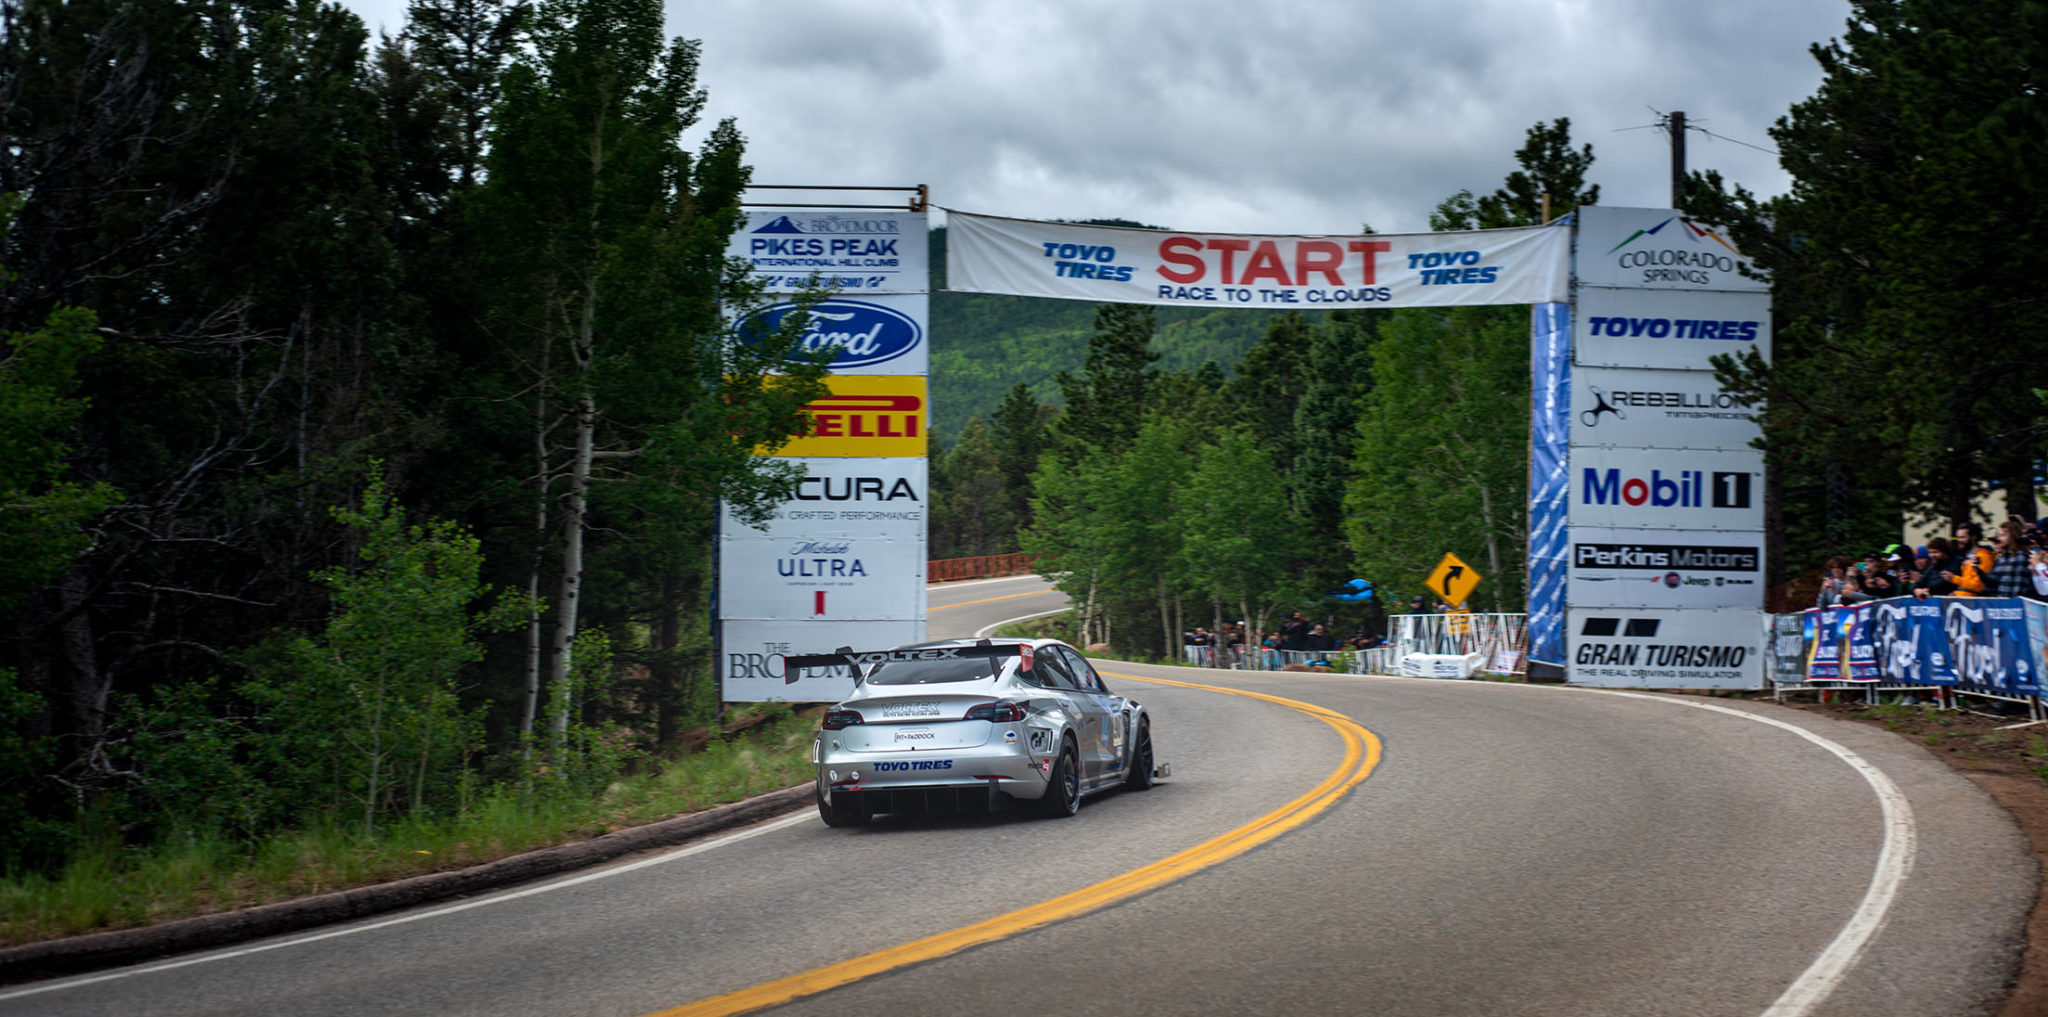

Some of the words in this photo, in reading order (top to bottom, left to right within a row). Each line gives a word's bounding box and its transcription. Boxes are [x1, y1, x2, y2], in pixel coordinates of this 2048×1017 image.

[810, 220, 899, 232] BROADMOOR
[750, 238, 825, 256] PIKES
[830, 238, 899, 256] PEAK
[1043, 242, 1116, 263] TOYO
[751, 258, 836, 266] INTERNATIONAL
[864, 259, 900, 267] CLIMB
[1156, 236, 1391, 286] START
[1407, 251, 1480, 269] TOYO
[1619, 249, 1734, 273] COLORADO
[1054, 260, 1135, 282] TIRES
[1420, 265, 1499, 286] TIRES
[1643, 268, 1710, 285] SPRINGS
[1158, 285, 1218, 301] RACE
[1225, 288, 1252, 302] TO
[1259, 289, 1299, 303] THE
[1306, 287, 1392, 303] CLOUDS
[1589, 316, 1672, 339] TOYO
[1675, 319, 1759, 341] TIRES
[758, 477, 919, 501] ACURA
[1583, 467, 1703, 508] Mobil
[1722, 474, 1738, 506] 1
[788, 511, 837, 521] CRAFTED
[840, 511, 921, 521] PERFORMANCE
[1578, 546, 1670, 566] Perkins
[1671, 549, 1755, 568] Motors
[777, 558, 867, 577] ULTRA
[763, 642, 792, 654] THE
[844, 648, 960, 665] VOLTEX
[1576, 643, 1639, 666] GRAN
[1645, 644, 1746, 668] TURISMO
[1578, 668, 1598, 677] THE
[1600, 669, 1628, 677] REAL
[1630, 669, 1675, 678] DRIVING
[1678, 670, 1743, 679] SIMULATOR
[881, 702, 942, 713] VOLTEX
[873, 762, 909, 772] TOYO
[912, 760, 953, 770] TIRES
